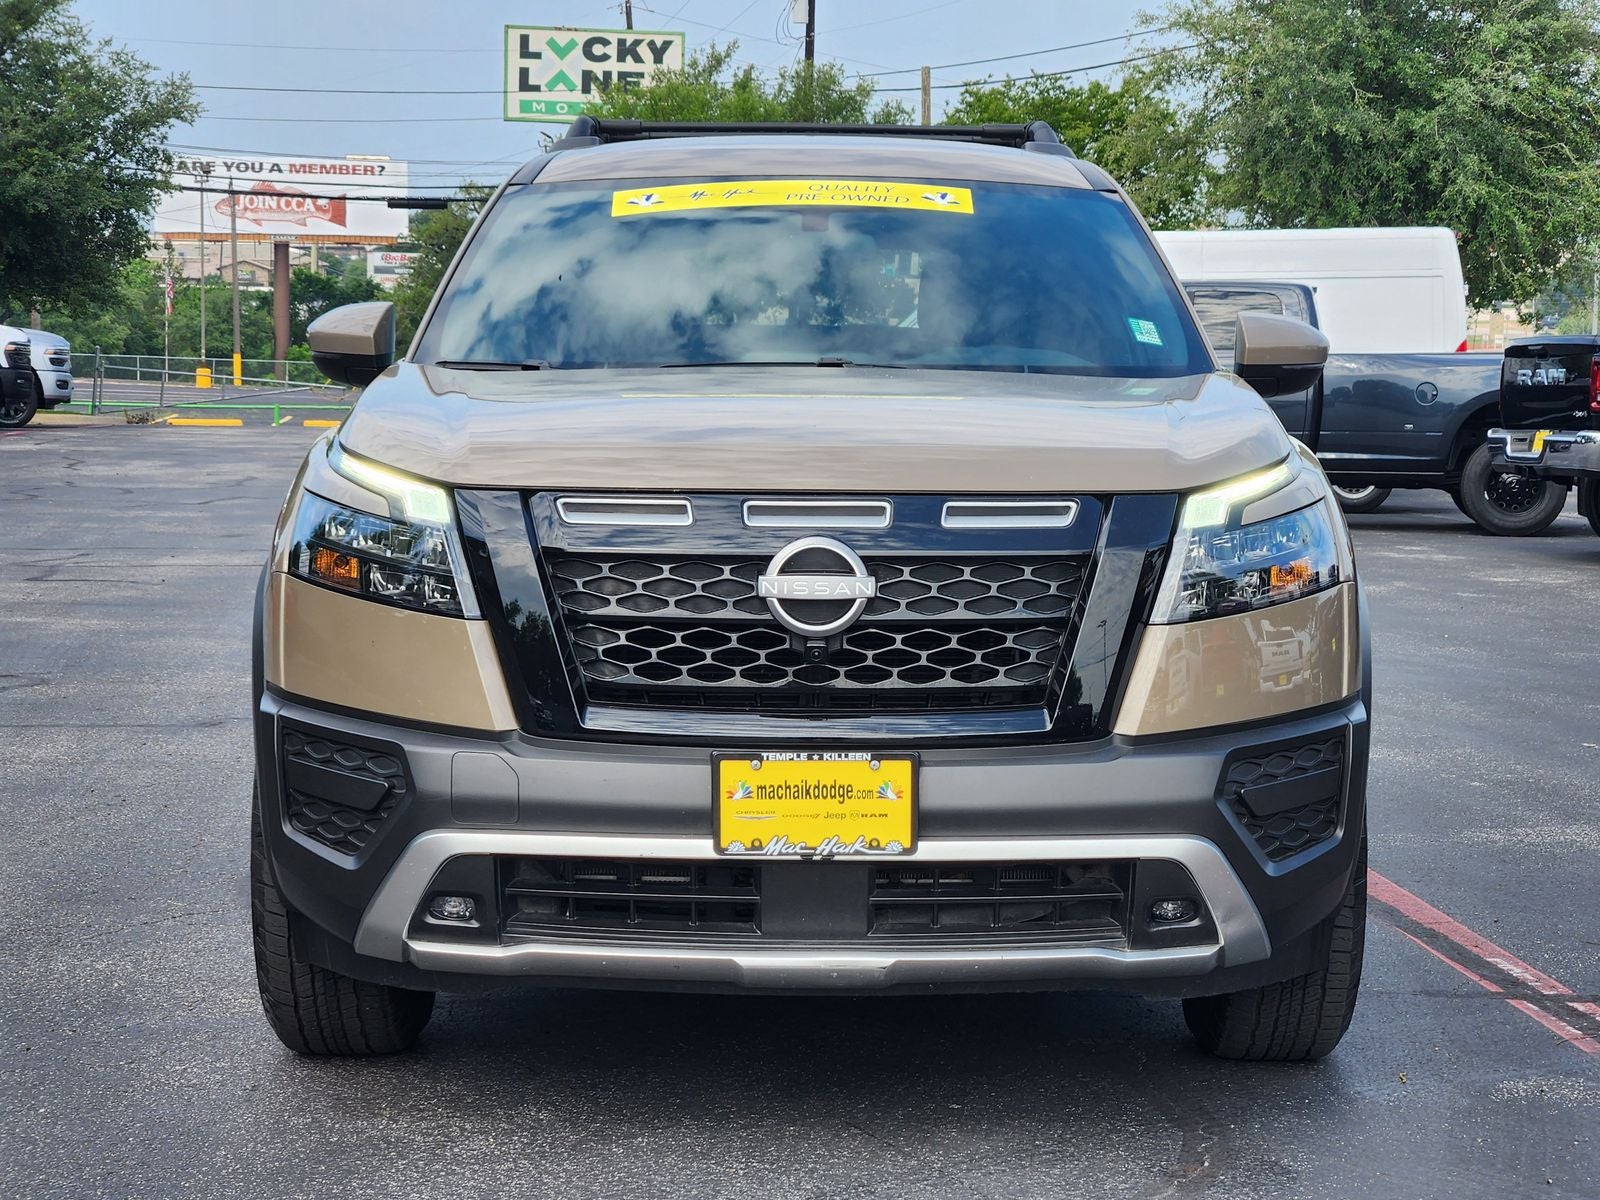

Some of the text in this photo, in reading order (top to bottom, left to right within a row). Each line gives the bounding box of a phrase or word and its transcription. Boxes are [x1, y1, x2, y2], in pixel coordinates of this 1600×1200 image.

[177, 160, 386, 176] ARE YOU A MEMBER?
[808, 183, 895, 193] QUALITY
[235, 194, 316, 212] JOIN CCA
[1516, 368, 1566, 386] RAM
[761, 581, 872, 595] NISSAN
[761, 752, 872, 761] TEMPLE KILLEEN
[756, 779, 874, 804] machaikdodge.com
[823, 811, 847, 820] Jeep
[763, 834, 868, 856] Mac Haik
